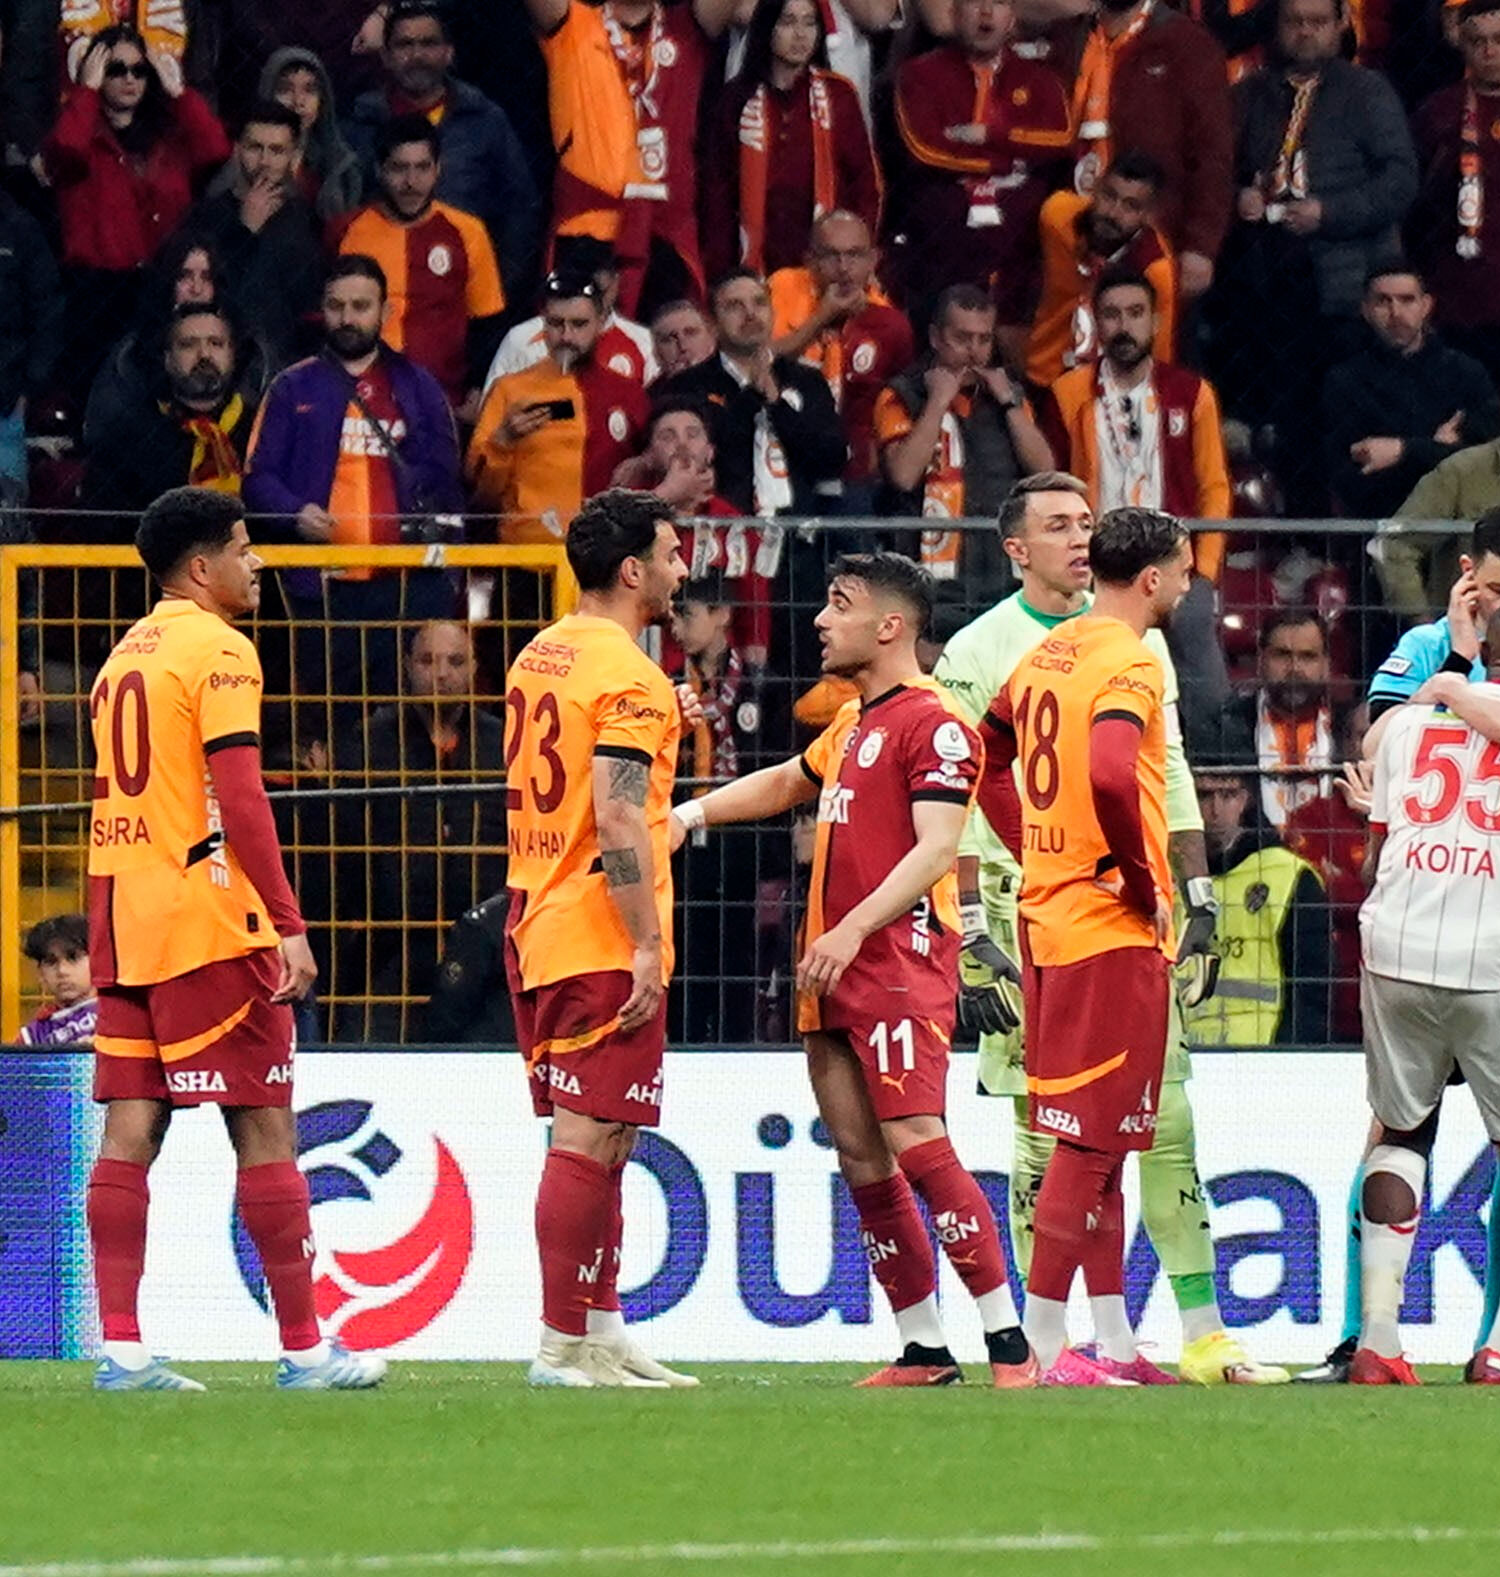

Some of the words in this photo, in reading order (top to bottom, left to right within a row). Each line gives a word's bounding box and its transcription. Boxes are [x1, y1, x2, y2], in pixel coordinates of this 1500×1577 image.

[507, 687, 567, 814] 23
[1014, 686, 1060, 811] 18
[868, 1018, 915, 1074] 11
[866, 1238, 899, 1264] GN
